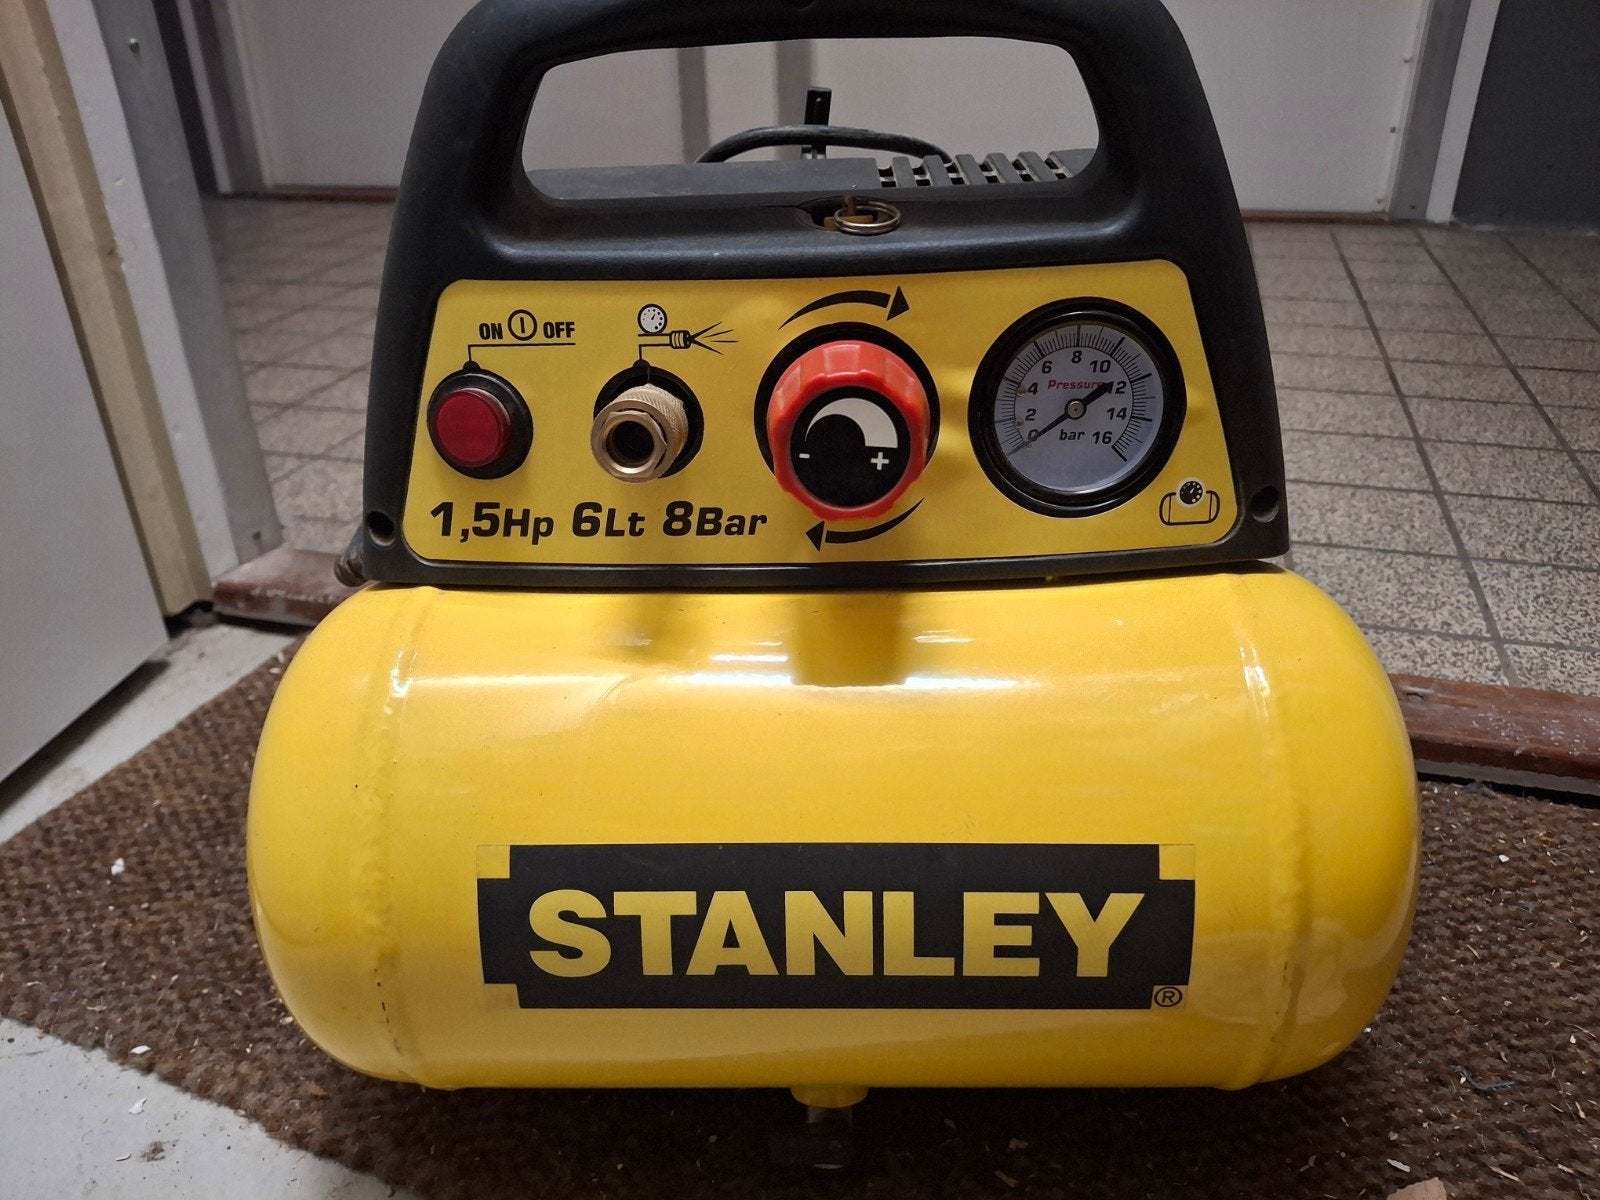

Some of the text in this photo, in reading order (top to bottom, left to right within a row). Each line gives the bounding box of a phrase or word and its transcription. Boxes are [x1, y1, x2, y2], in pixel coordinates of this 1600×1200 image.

[478, 321, 576, 340] ON OFF
[1071, 350, 1082, 363] 8
[1041, 360, 1052, 374] 6
[1089, 359, 1111, 373] 10
[1027, 381, 1038, 395] 4
[1047, 379, 1105, 390] Pressure
[1106, 380, 1127, 394] 12
[1025, 408, 1037, 421] 2
[1106, 407, 1127, 420] 14
[1058, 428, 1085, 441] bar
[1092, 430, 1112, 444] 16
[430, 500, 768, 546] 1,5Hp 6Lt 8Bar
[528, 888, 1146, 978] STANLEY
